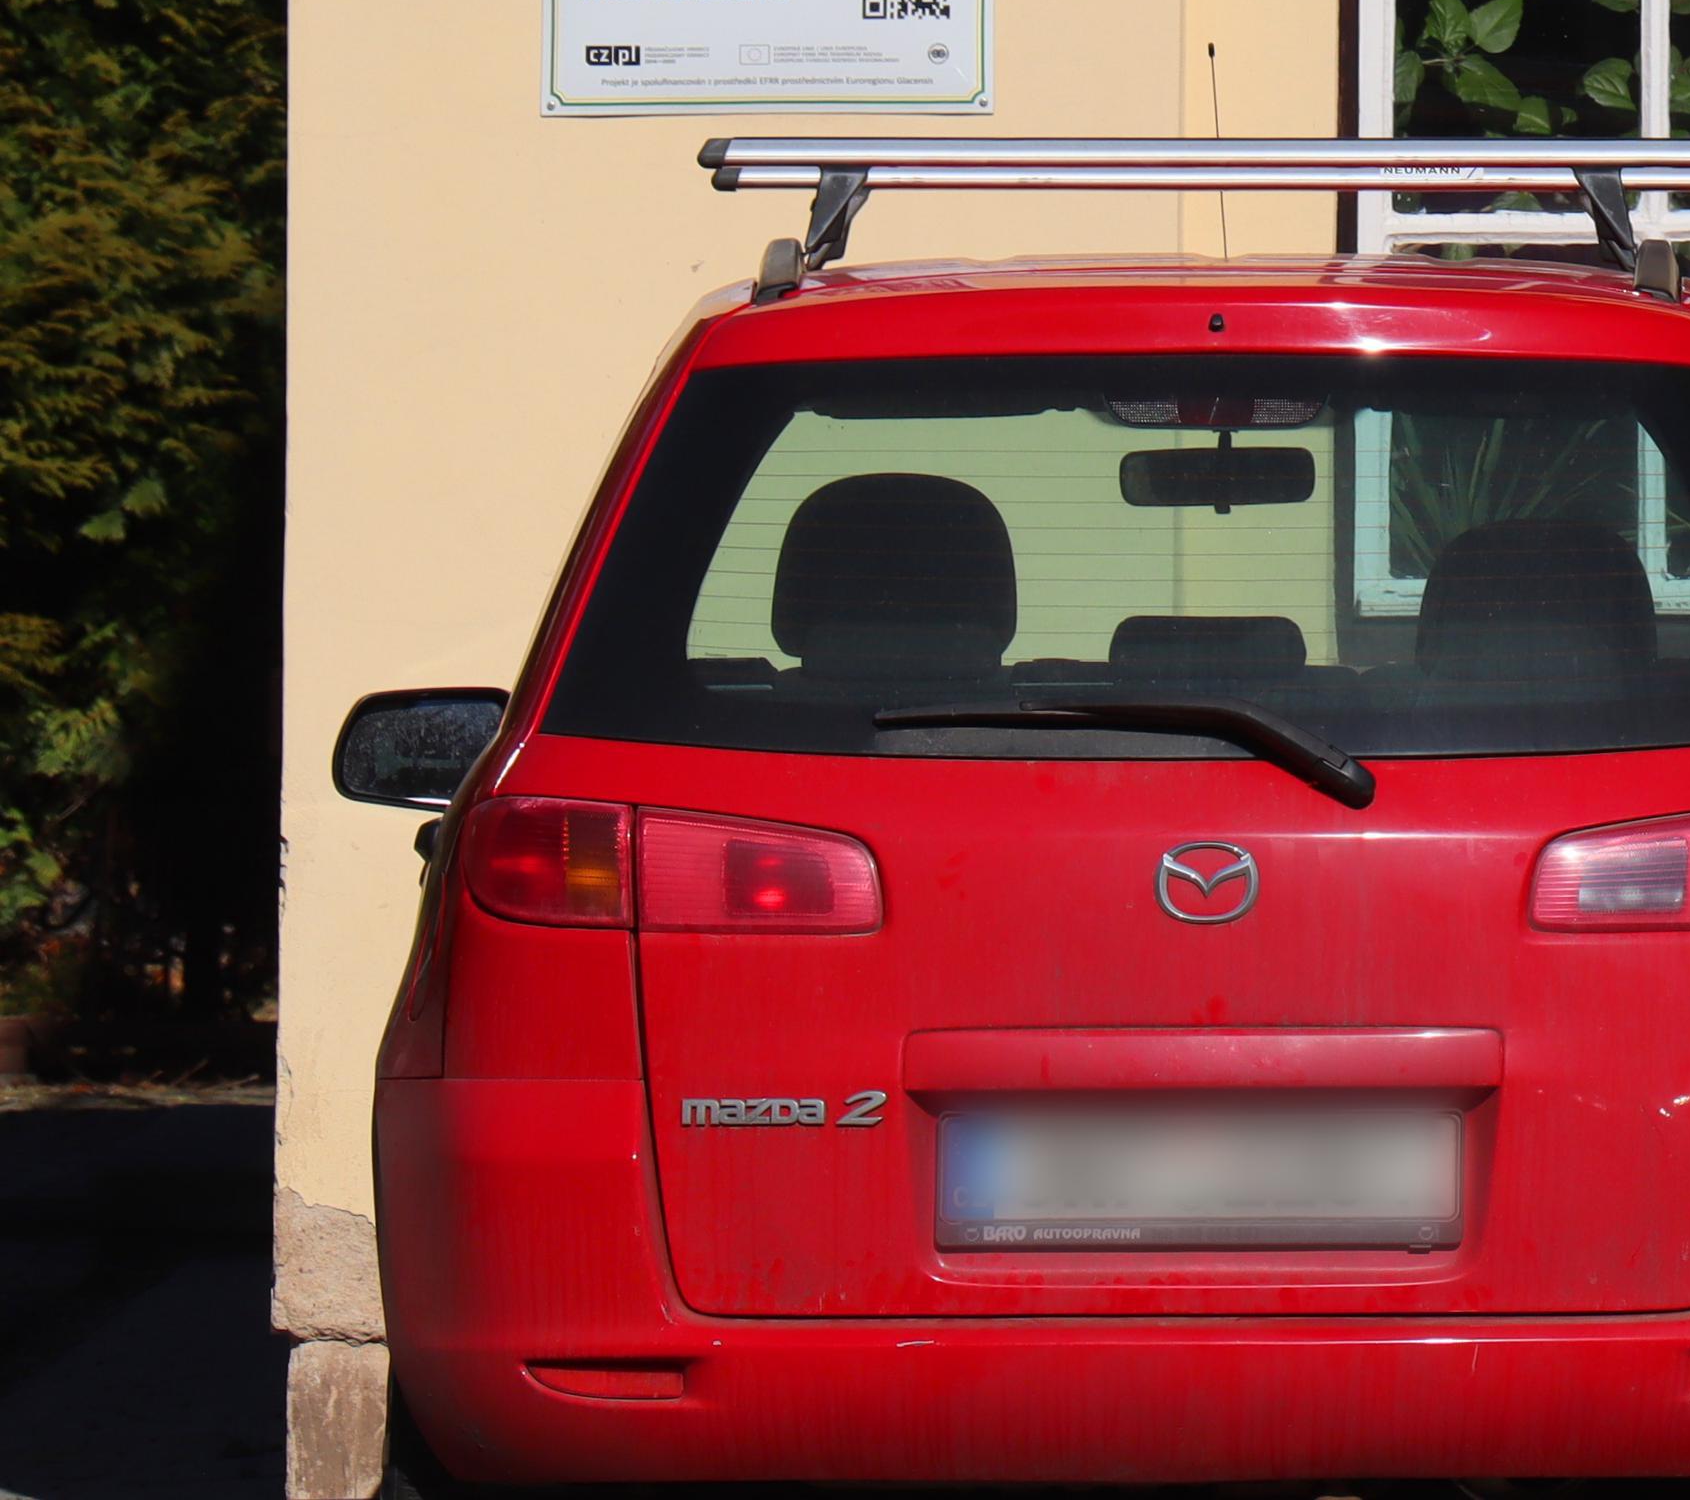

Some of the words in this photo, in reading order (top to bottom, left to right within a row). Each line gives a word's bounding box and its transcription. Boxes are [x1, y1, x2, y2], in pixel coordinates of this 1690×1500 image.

[1383, 166, 1461, 174] NEUMANN
[836, 1090, 887, 1127] 2
[1033, 1227, 1141, 1240] AUTOOPRAVNA
